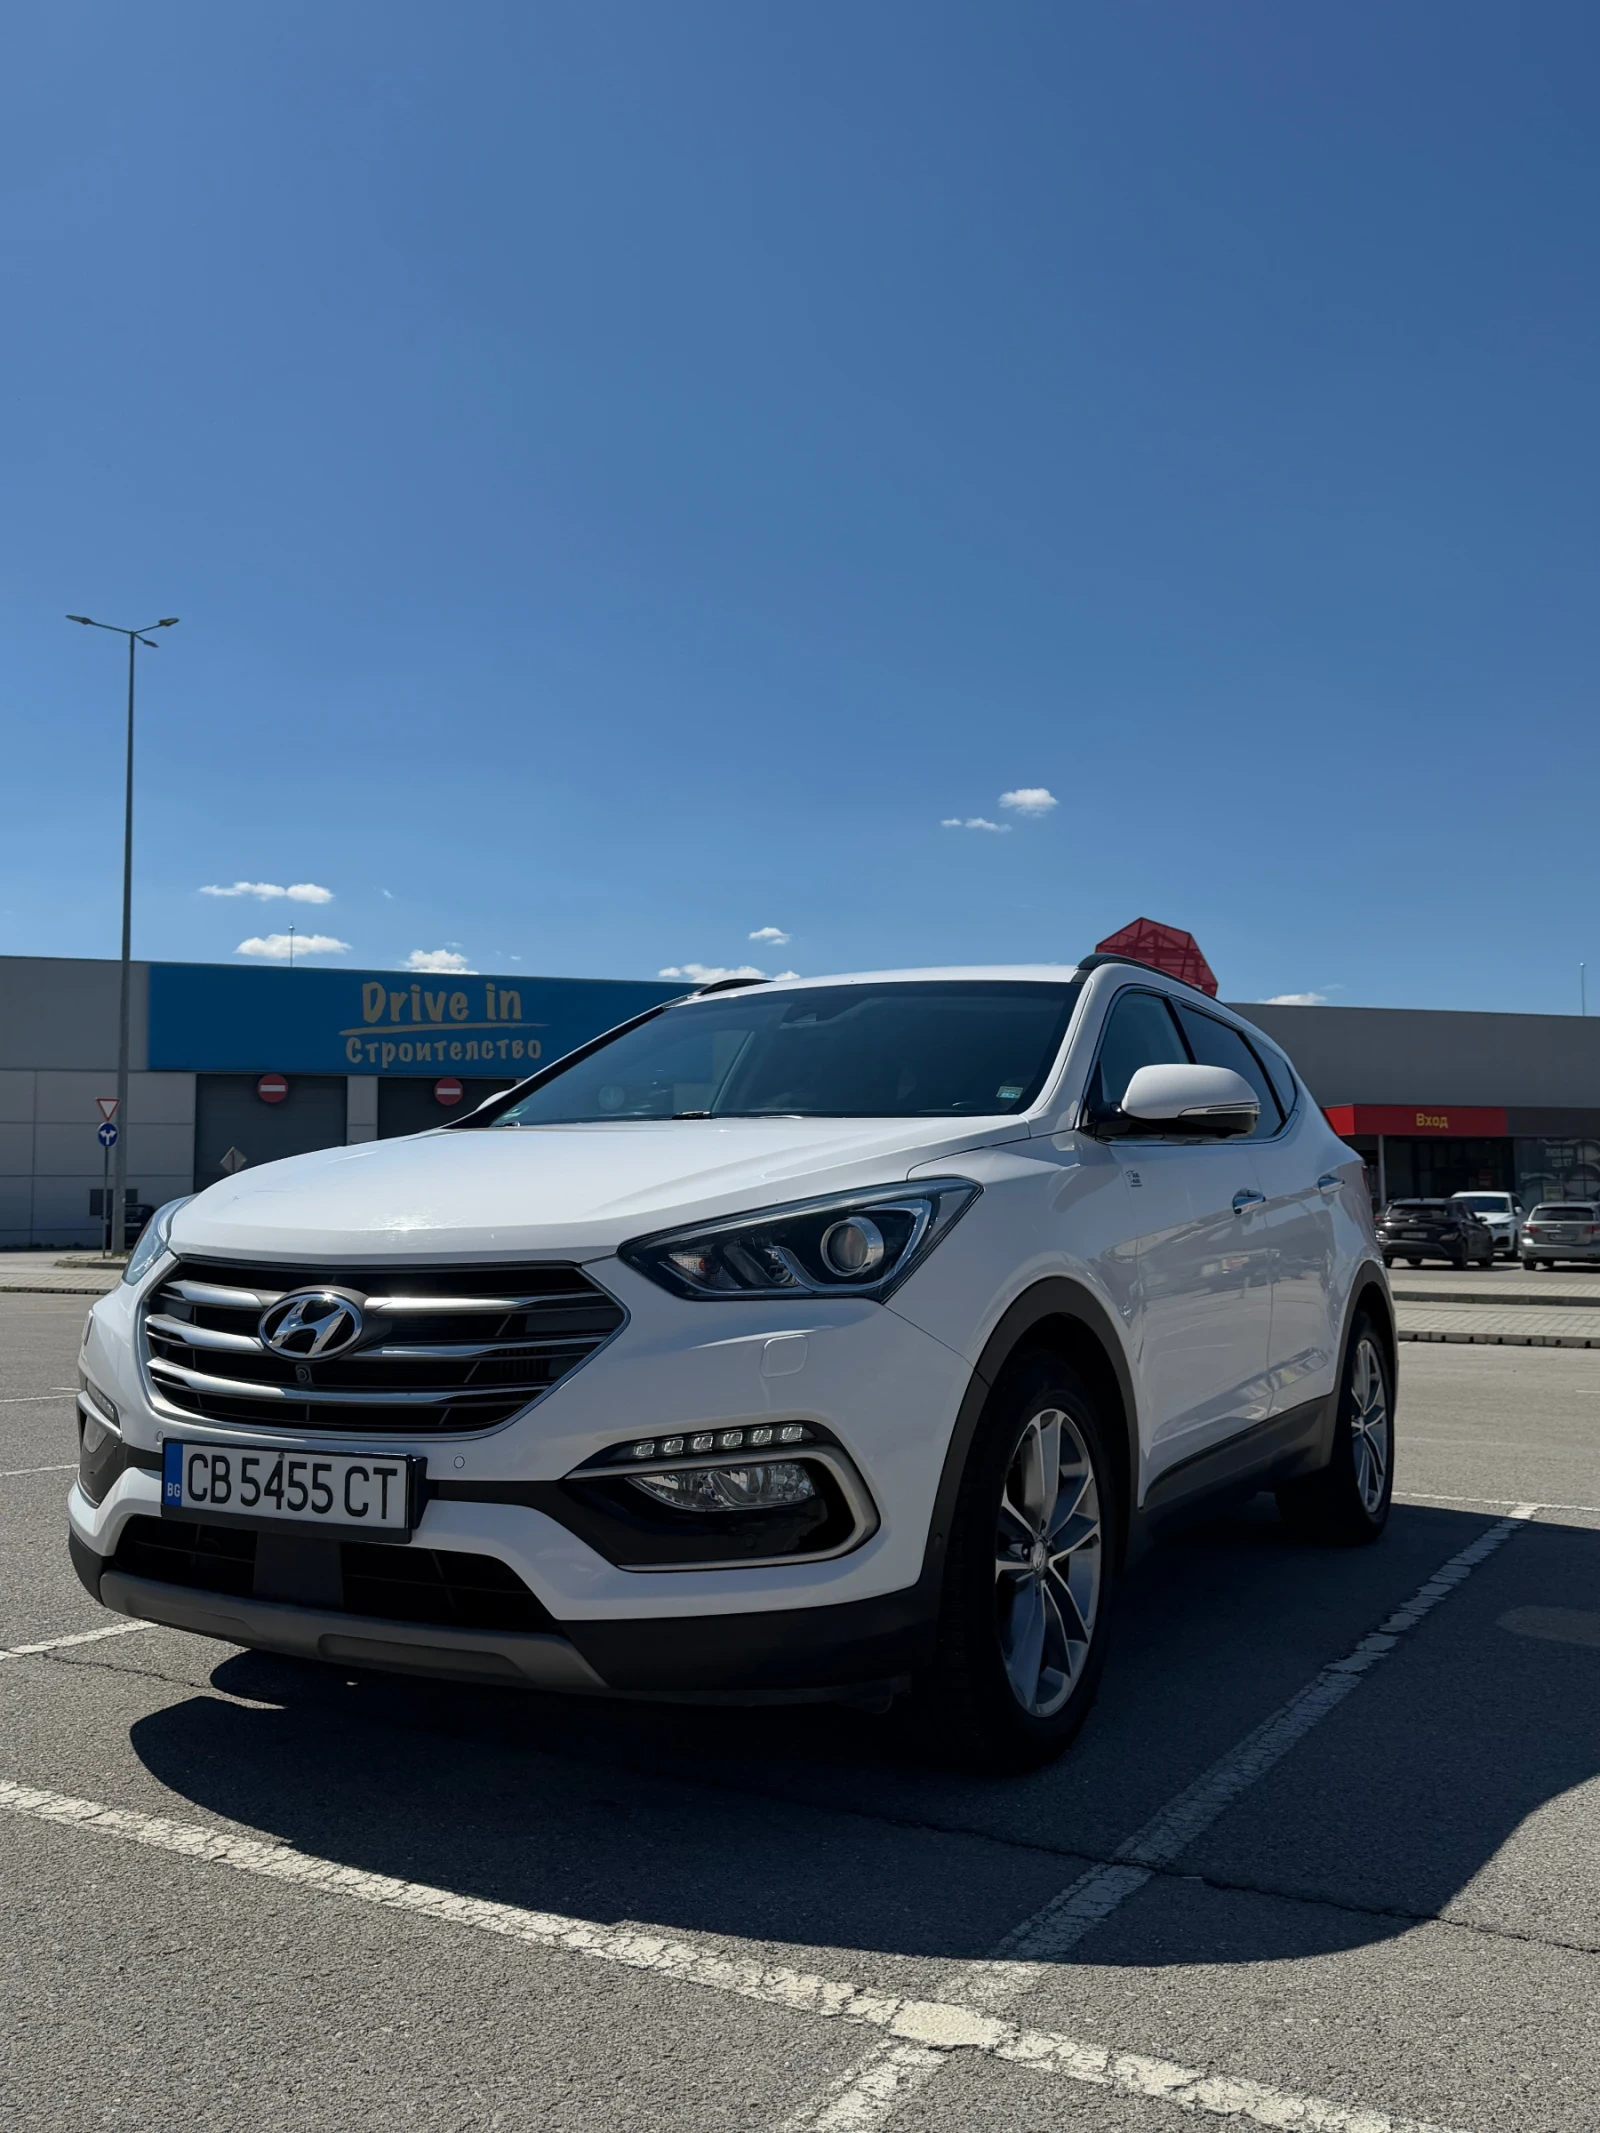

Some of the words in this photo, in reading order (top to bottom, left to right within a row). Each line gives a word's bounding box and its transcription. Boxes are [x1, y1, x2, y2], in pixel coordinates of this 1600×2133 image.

[362, 981, 470, 1024] Drive
[485, 983, 522, 1020] in
[345, 1036, 542, 1069] Строителство
[1416, 1113, 1449, 1129] Вход
[166, 1482, 181, 1498] BG
